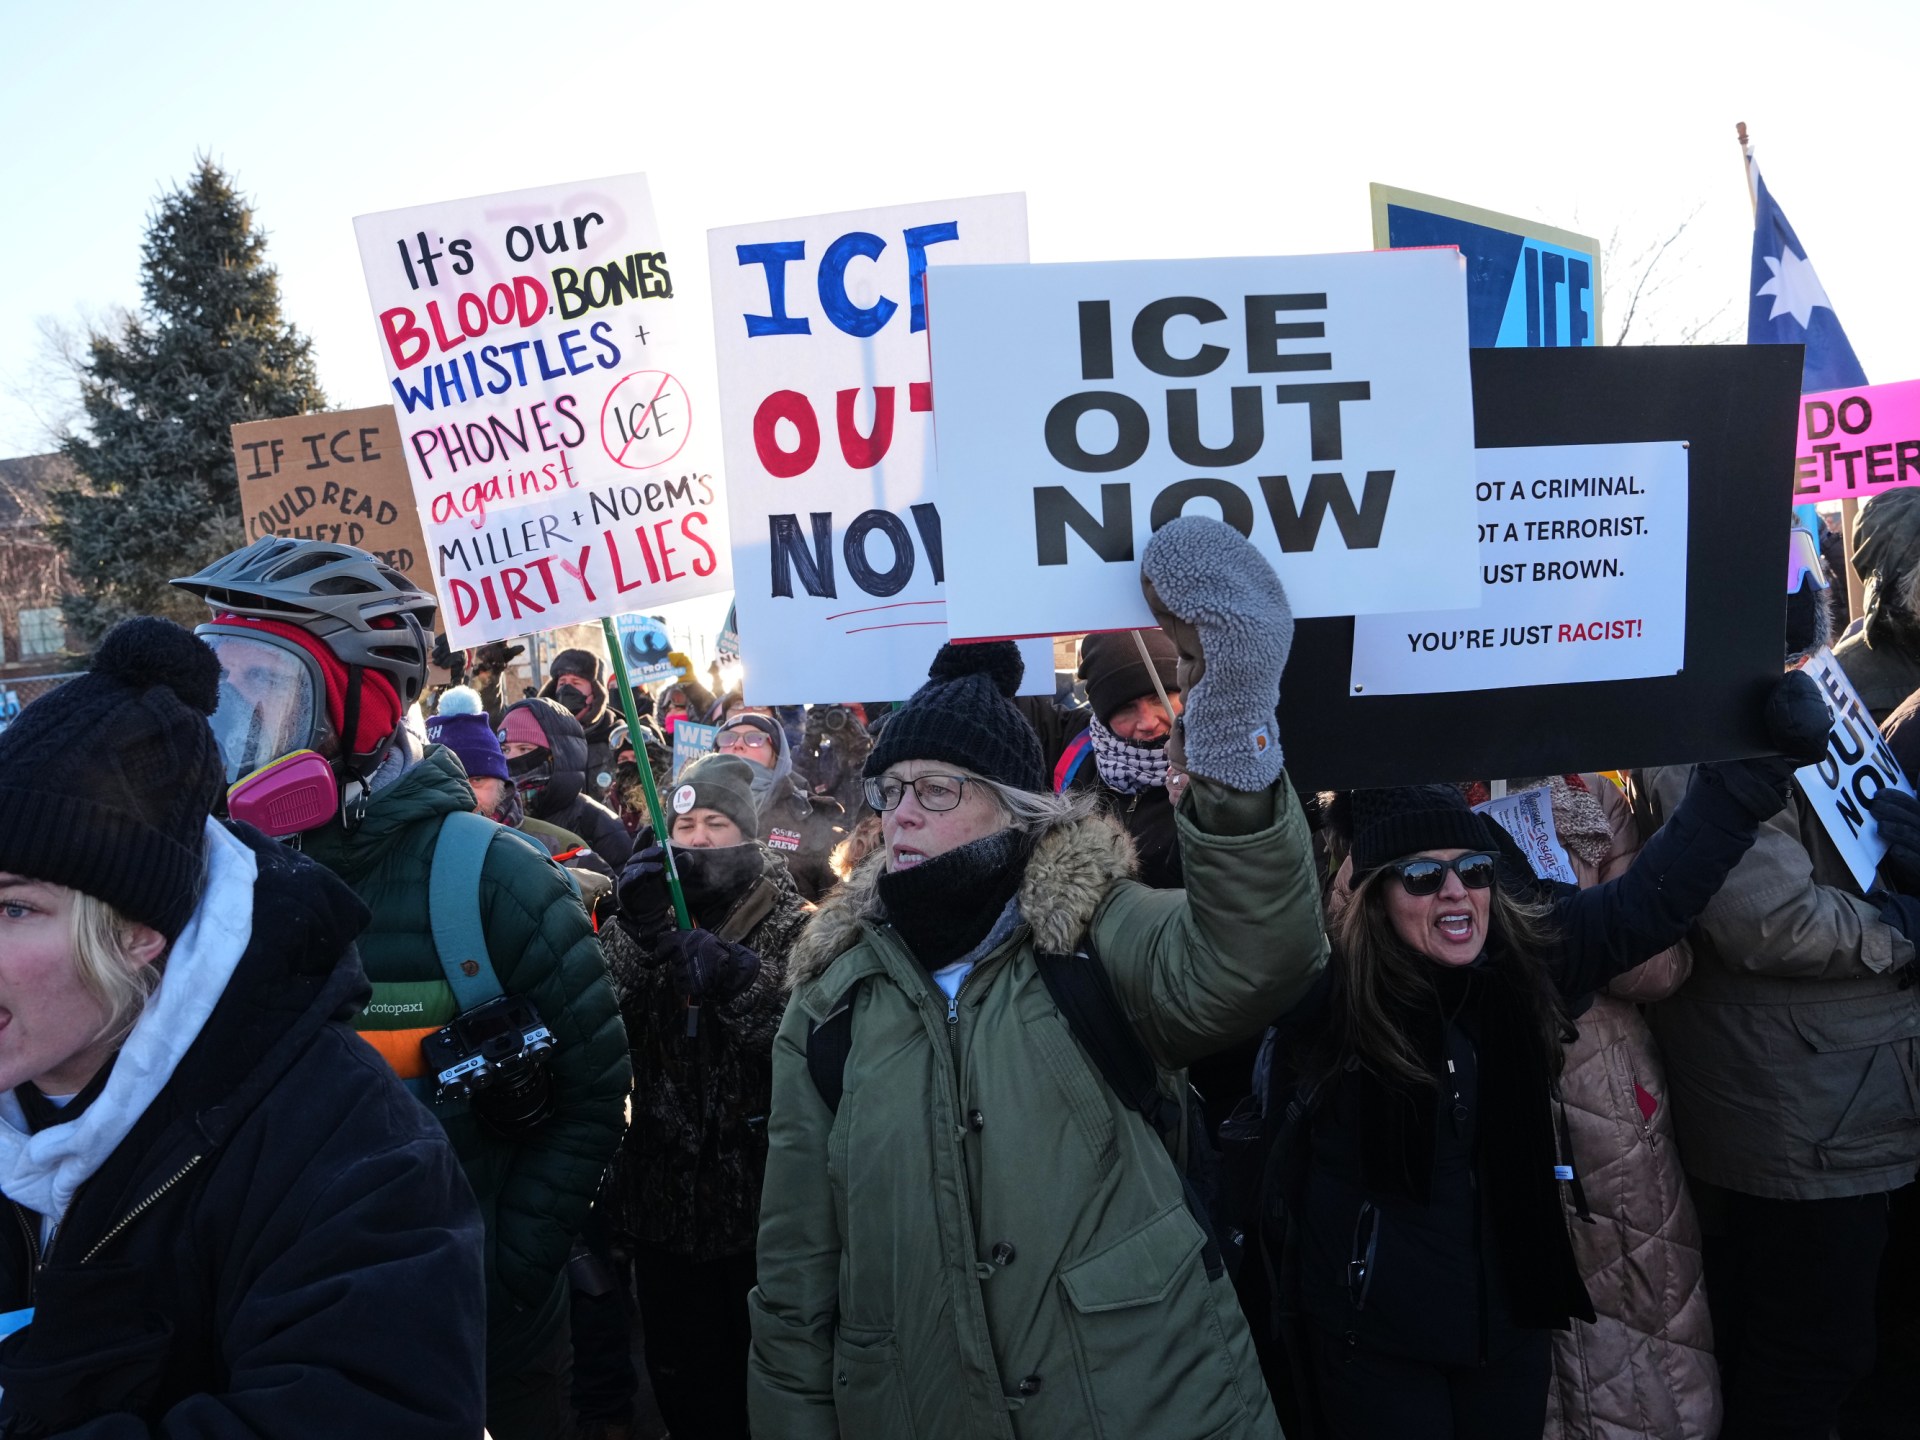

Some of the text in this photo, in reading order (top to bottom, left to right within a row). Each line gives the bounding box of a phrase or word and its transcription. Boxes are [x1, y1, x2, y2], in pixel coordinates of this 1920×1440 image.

[397, 211, 604, 290] It's our
[1078, 292, 1333, 381] ICE
[392, 321, 622, 414] WHISTLES
[410, 394, 586, 480] PHONES
[613, 393, 676, 445] ICE
[752, 382, 934, 479] OU
[1043, 381, 1371, 473] OUT
[1805, 396, 1872, 440] DO
[241, 428, 382, 480] IF ICE
[1794, 440, 1920, 495] ETTER
[321, 481, 398, 525] READ
[431, 450, 580, 530] against
[1476, 475, 1645, 501] OT A CRIMINAL.
[437, 514, 573, 576] MILLER
[1503, 522, 1519, 542] A
[1524, 516, 1649, 541] TERRORIST.
[447, 511, 717, 627] DIRTY LIES
[1480, 558, 1624, 585] UST BROWN.
[1407, 619, 1643, 653] YOU'RE JUST RACIST!
[678, 723, 713, 748] WE
[768, 839, 799, 851] CREW
[1535, 832, 1557, 870] Resign
[370, 1001, 424, 1016] cotopaxi
